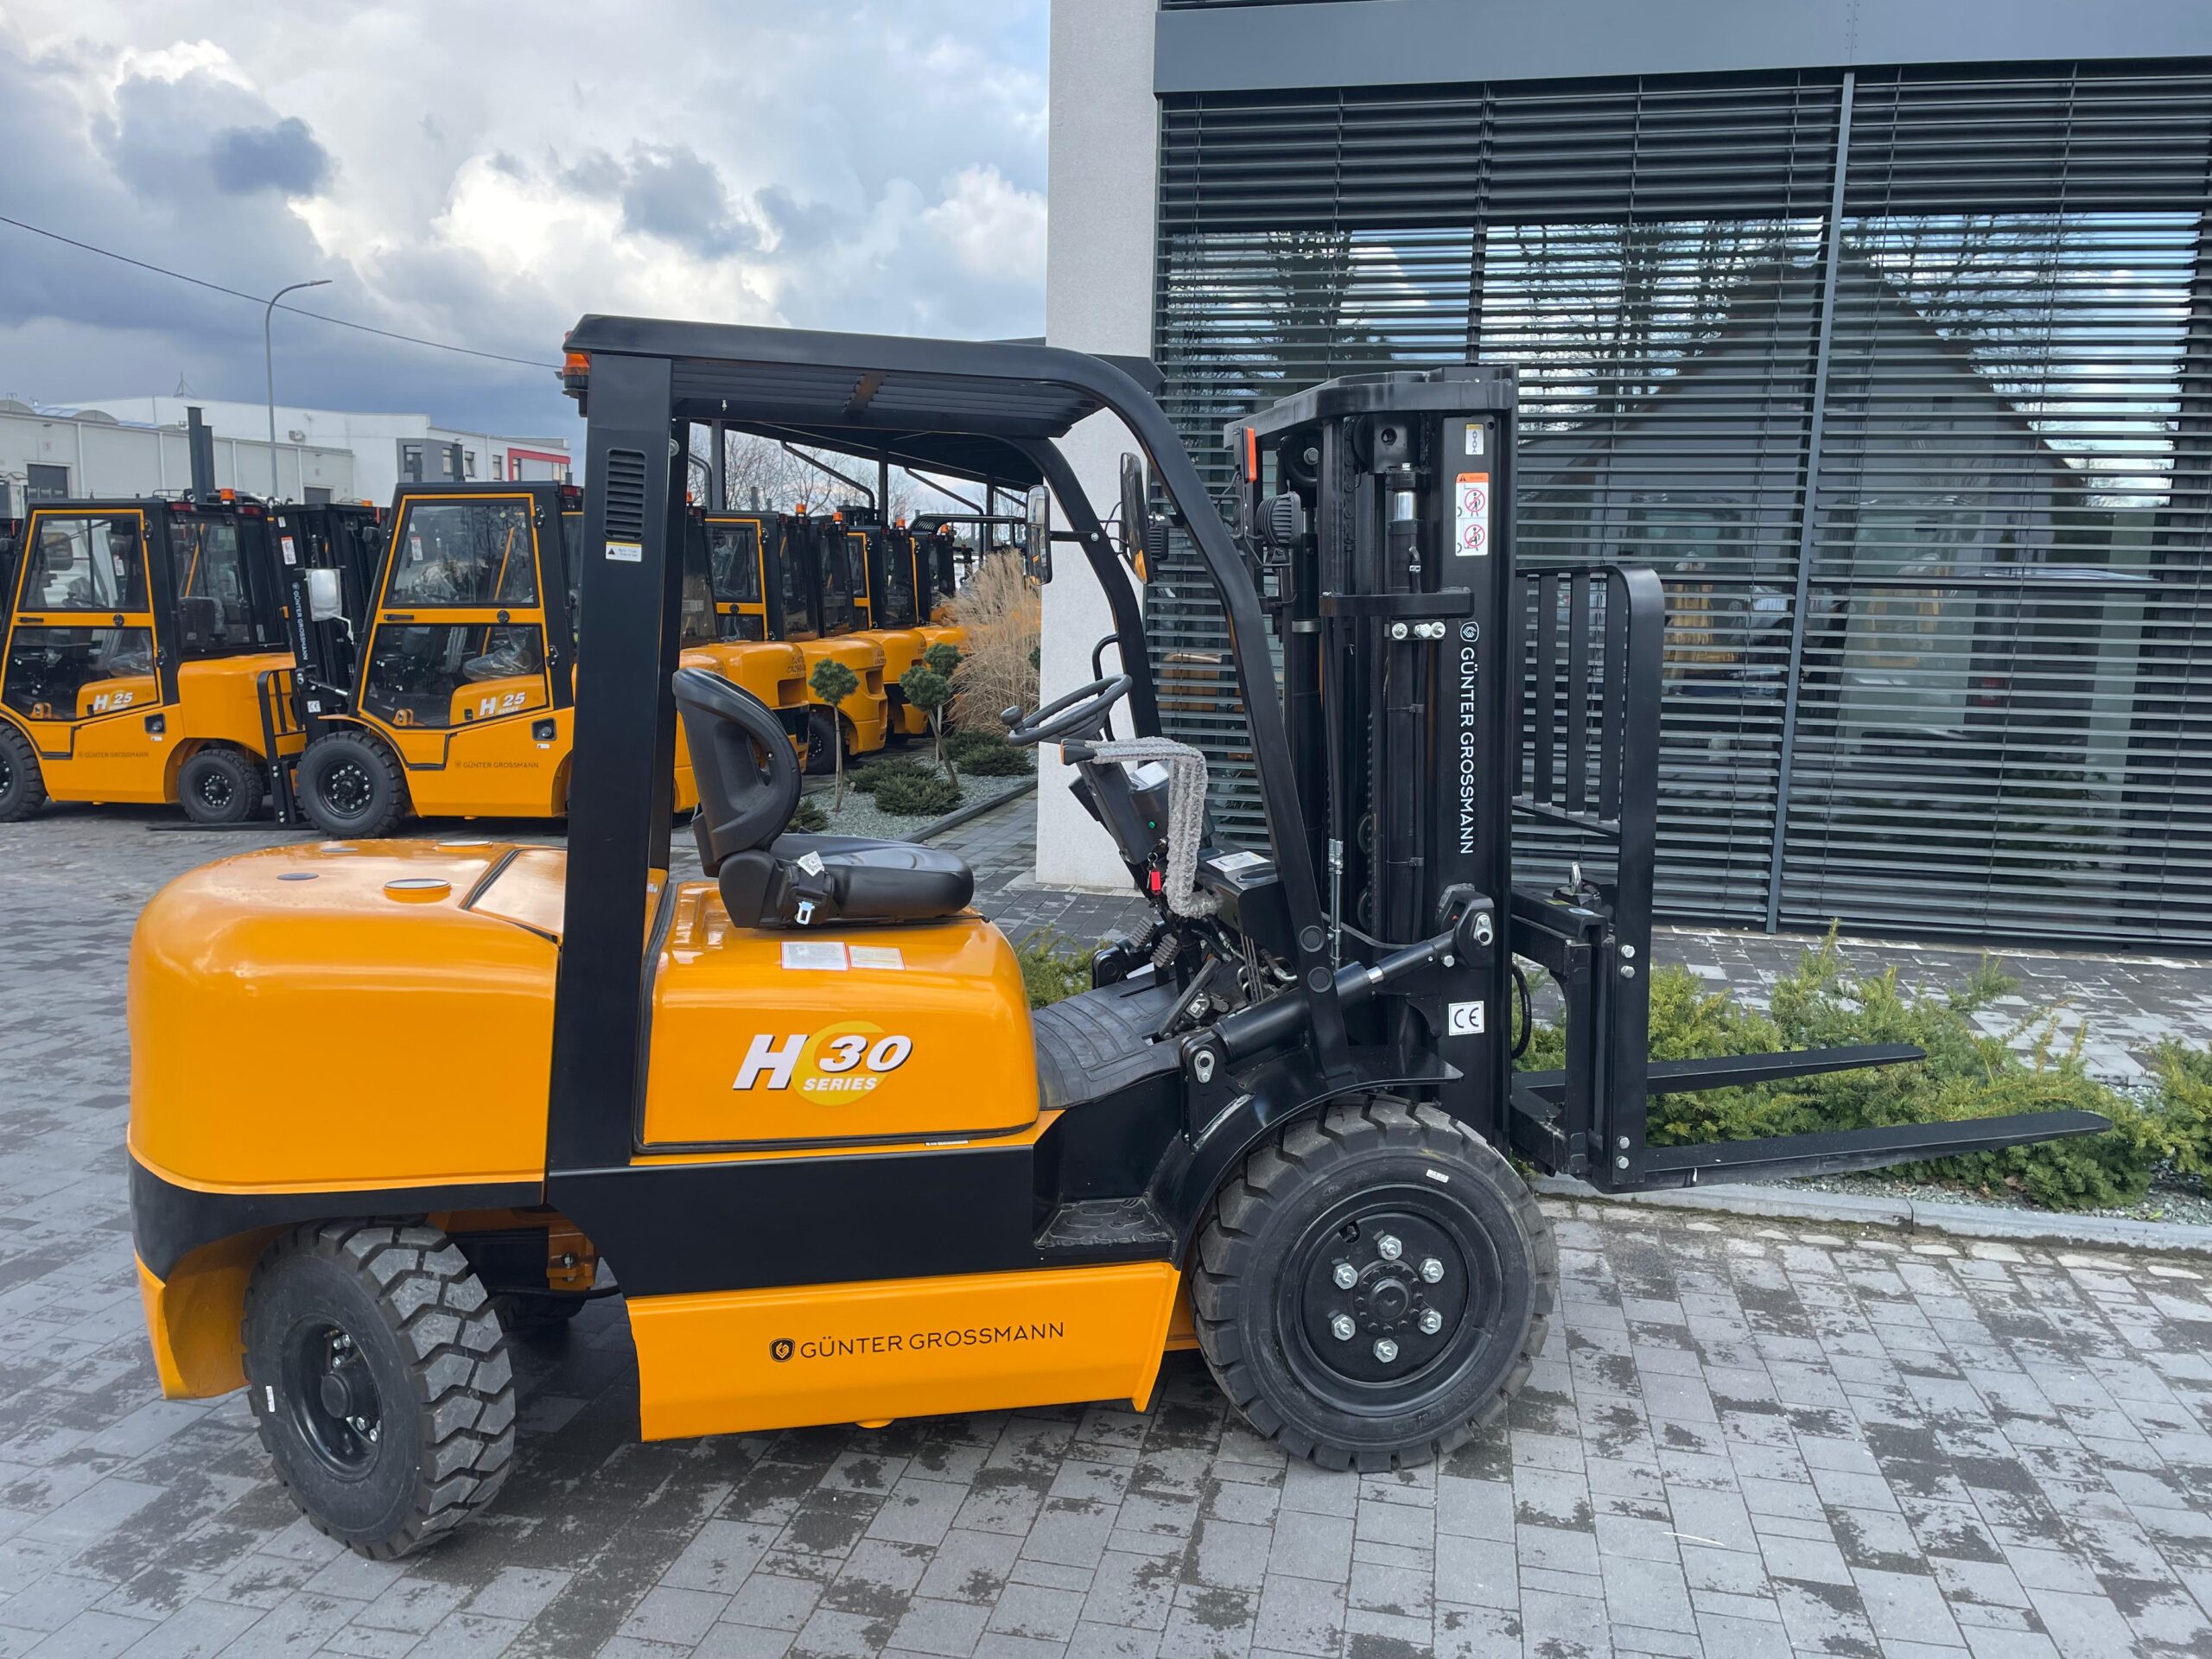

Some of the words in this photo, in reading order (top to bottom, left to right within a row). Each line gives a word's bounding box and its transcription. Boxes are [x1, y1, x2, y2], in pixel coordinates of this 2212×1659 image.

[93, 694, 109, 710] H
[113, 692, 134, 704] 25
[1460, 646, 1478, 728] GÜNTER
[480, 696, 497, 716] H
[503, 692, 525, 707] 25
[1460, 732, 1474, 854] GROSSMANN
[1453, 1007, 1479, 1029] CE
[732, 1034, 810, 1090] H
[819, 1035, 913, 1073] 30
[803, 1077, 878, 1091] SERIES
[800, 1336, 903, 1358] GÜNTER
[909, 1321, 1065, 1350] GROSSMANN
